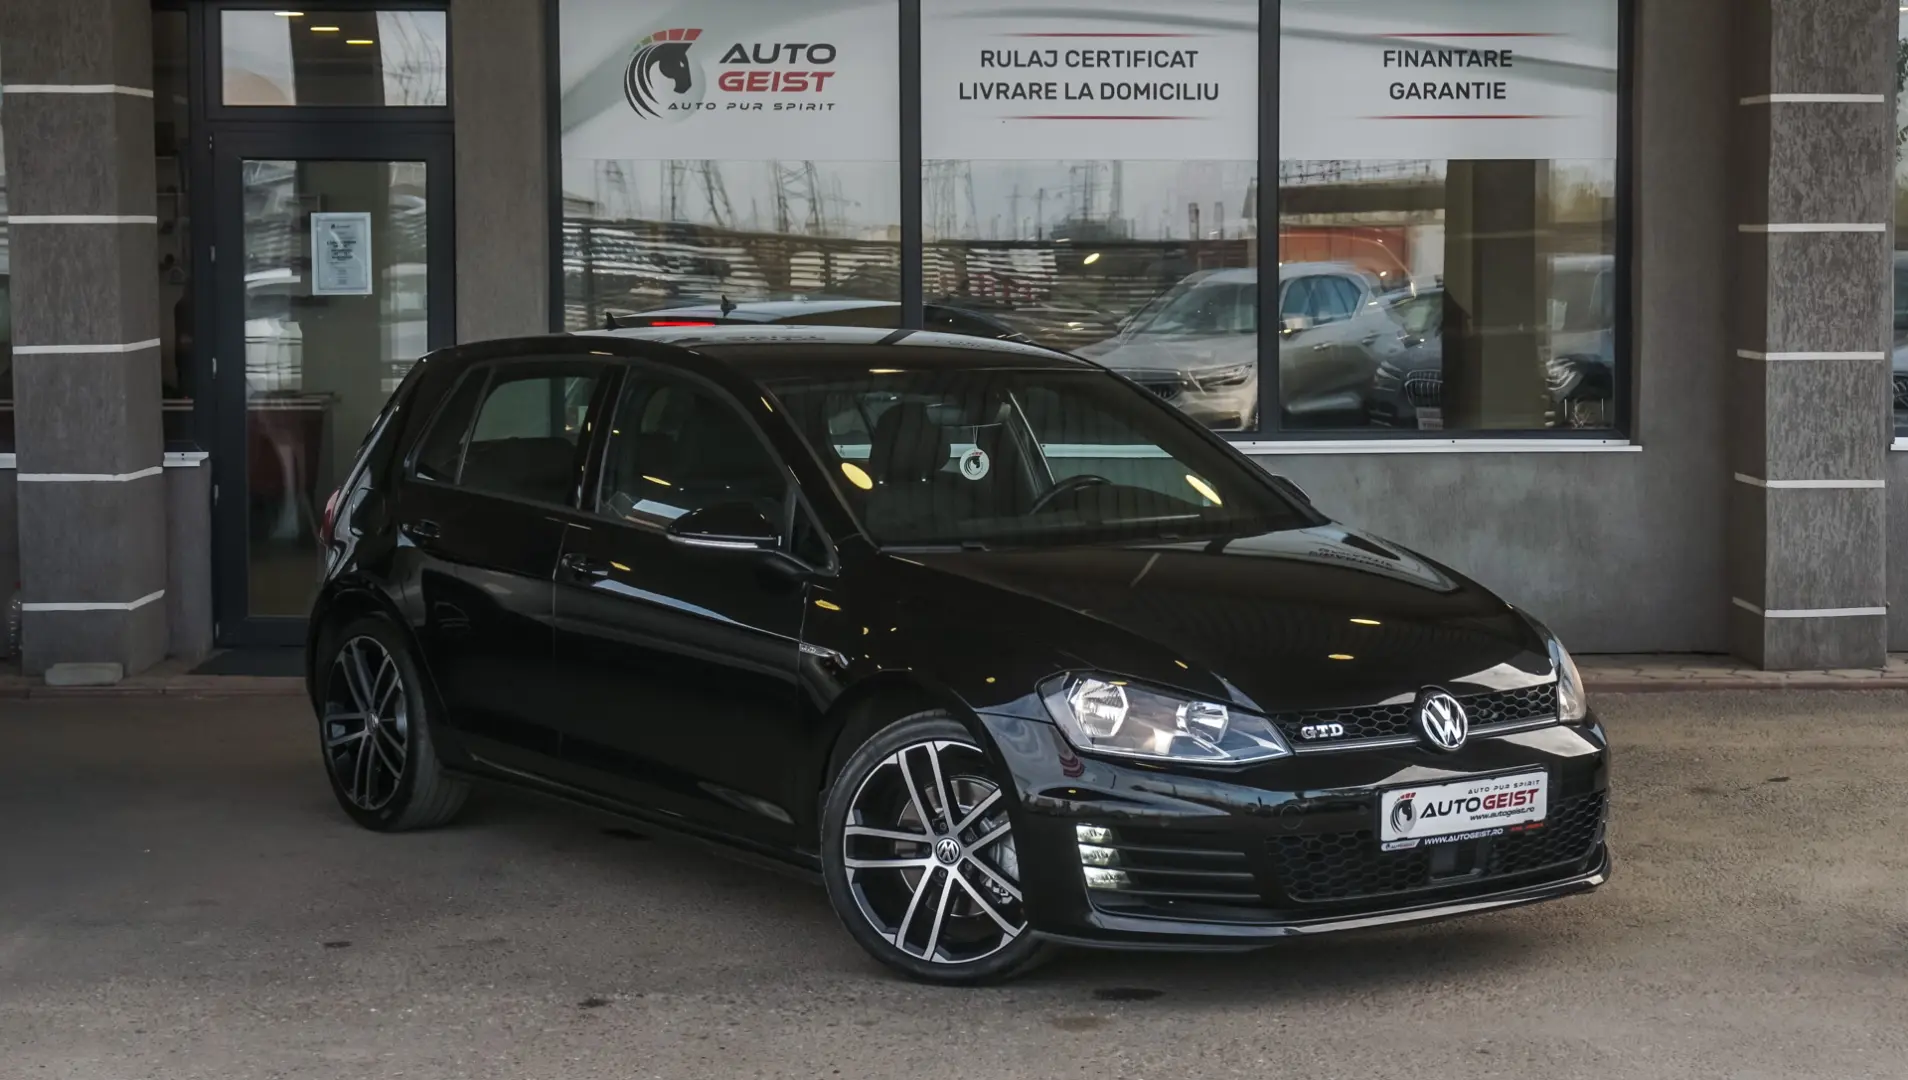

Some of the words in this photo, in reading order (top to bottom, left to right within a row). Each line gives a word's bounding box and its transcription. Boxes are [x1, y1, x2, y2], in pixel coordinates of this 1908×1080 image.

[718, 43, 837, 64] AUTO
[980, 50, 1058, 69] RULAJ
[1065, 50, 1199, 68] CERTIFICAT
[1383, 50, 1513, 68] FINANTARE
[718, 71, 836, 93] GEIST
[1389, 82, 1507, 100] GARANTIE
[959, 82, 1058, 100] LIVRARE
[1064, 82, 1095, 100] LA
[1100, 82, 1219, 101] DOMICILIU
[668, 102, 717, 111] AUTO
[726, 102, 763, 111] PUR
[773, 102, 836, 111] SPIRIT
[1301, 723, 1344, 740] GTD
[1468, 786, 1490, 794] AUTO
[1513, 779, 1540, 789] SPIRIT
[1470, 806, 1535, 821] www.autogeist.ro
[1424, 828, 1504, 846] WWW.AUTOGEIST.RO
